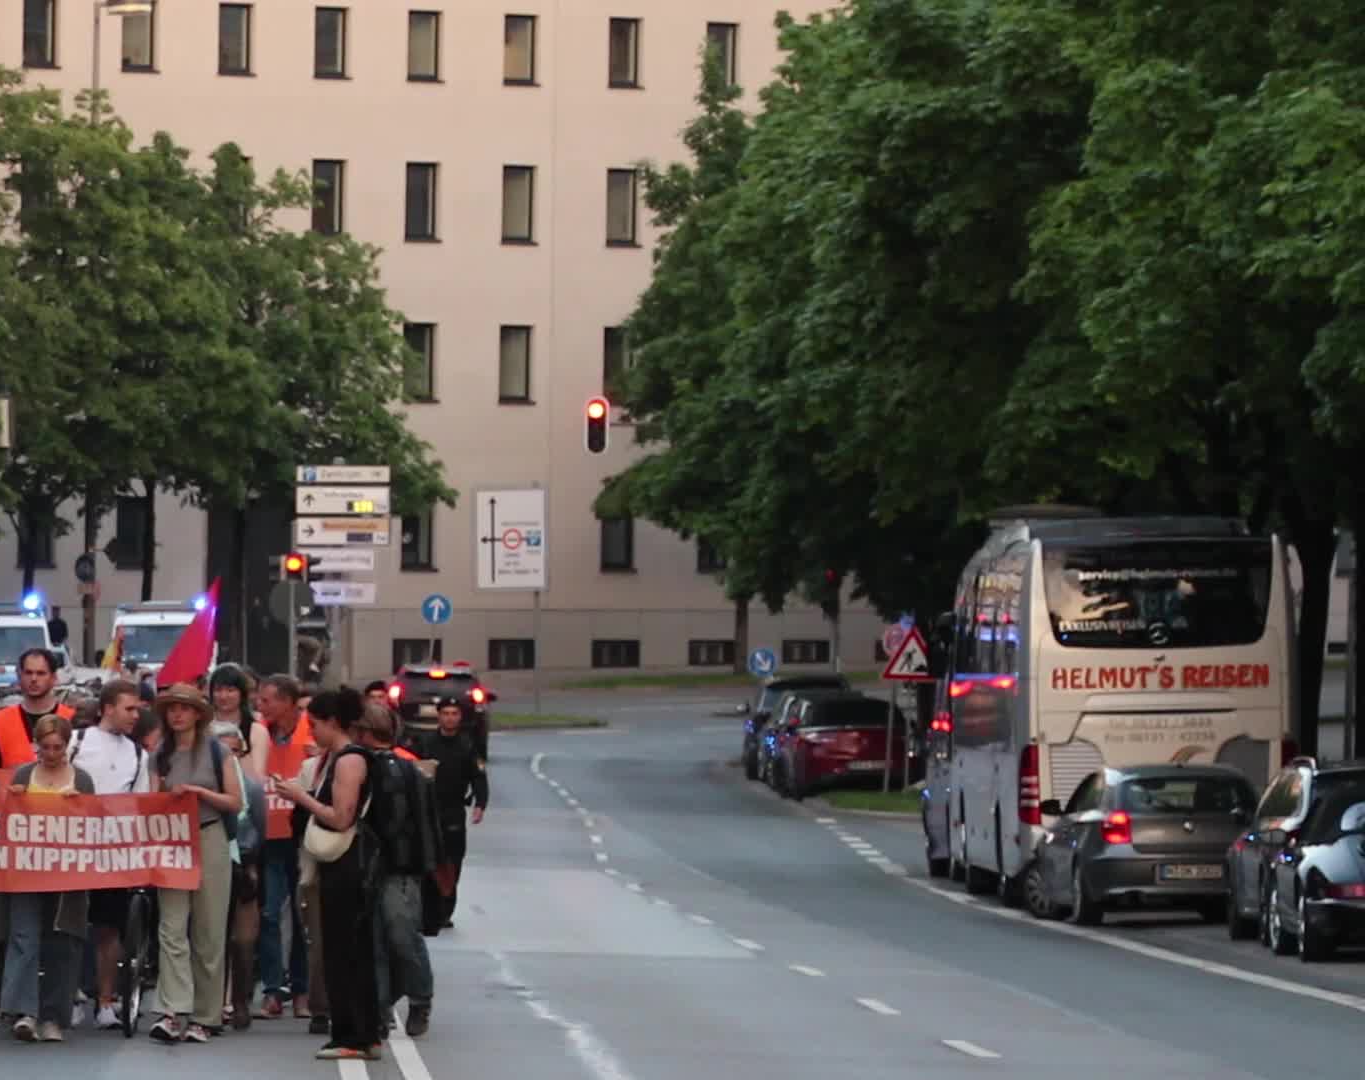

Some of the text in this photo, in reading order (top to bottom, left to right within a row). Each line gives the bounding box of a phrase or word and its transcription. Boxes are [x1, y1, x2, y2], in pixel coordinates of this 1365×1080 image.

[1181, 664, 1270, 688] REISEN
[7, 813, 190, 843] GENERATION
[15, 845, 192, 873] KIPPPUNKTEN
